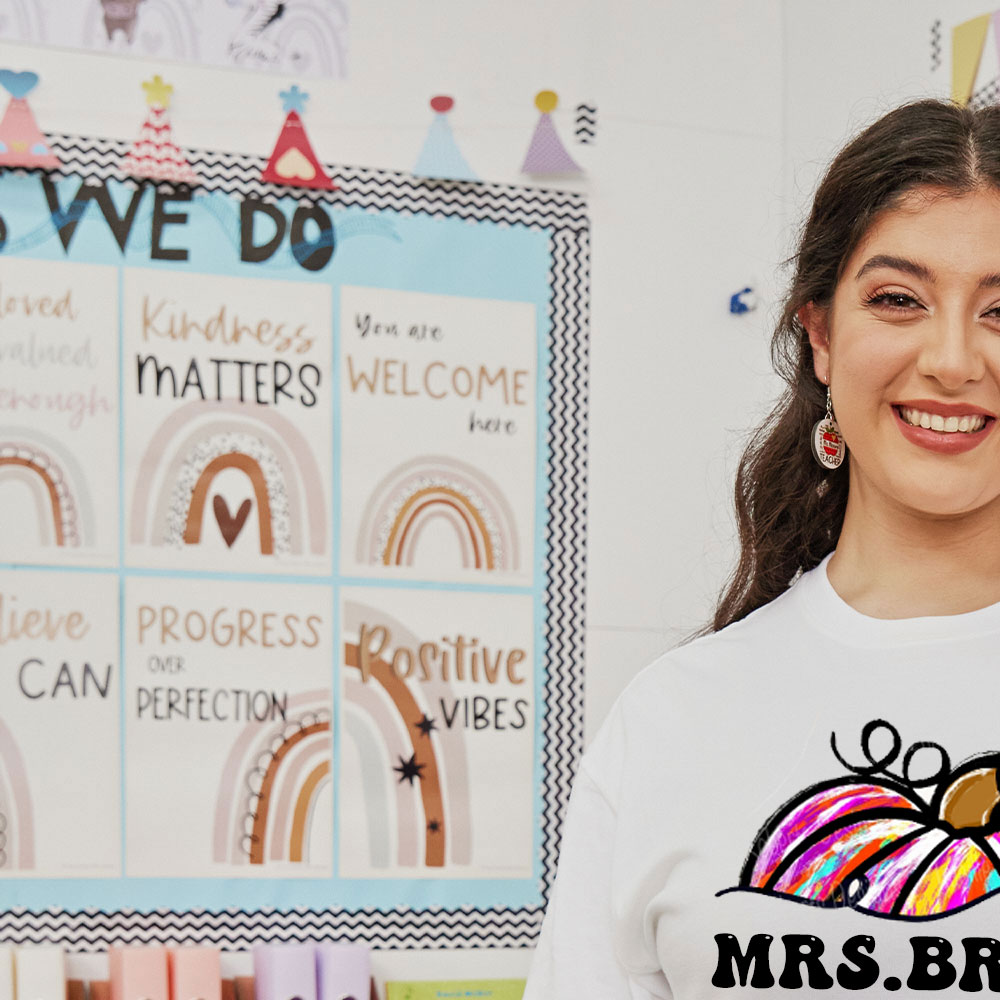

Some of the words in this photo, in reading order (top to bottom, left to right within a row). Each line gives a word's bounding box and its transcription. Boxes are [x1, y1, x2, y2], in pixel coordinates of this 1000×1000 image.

[42, 178, 195, 261] WE
[240, 200, 335, 271] DO
[142, 297, 315, 353] Kindness
[356, 313, 400, 341] You
[408, 323, 443, 342] are
[347, 356, 528, 406] WELCOME
[469, 411, 518, 435] here
[139, 605, 322, 648] PROGRESS
[148, 655, 186, 675] OVER
[359, 623, 527, 685] Positive
[18, 656, 112, 699] CAN
[137, 688, 288, 723] PERFECTION
[439, 697, 528, 730] VIBES
